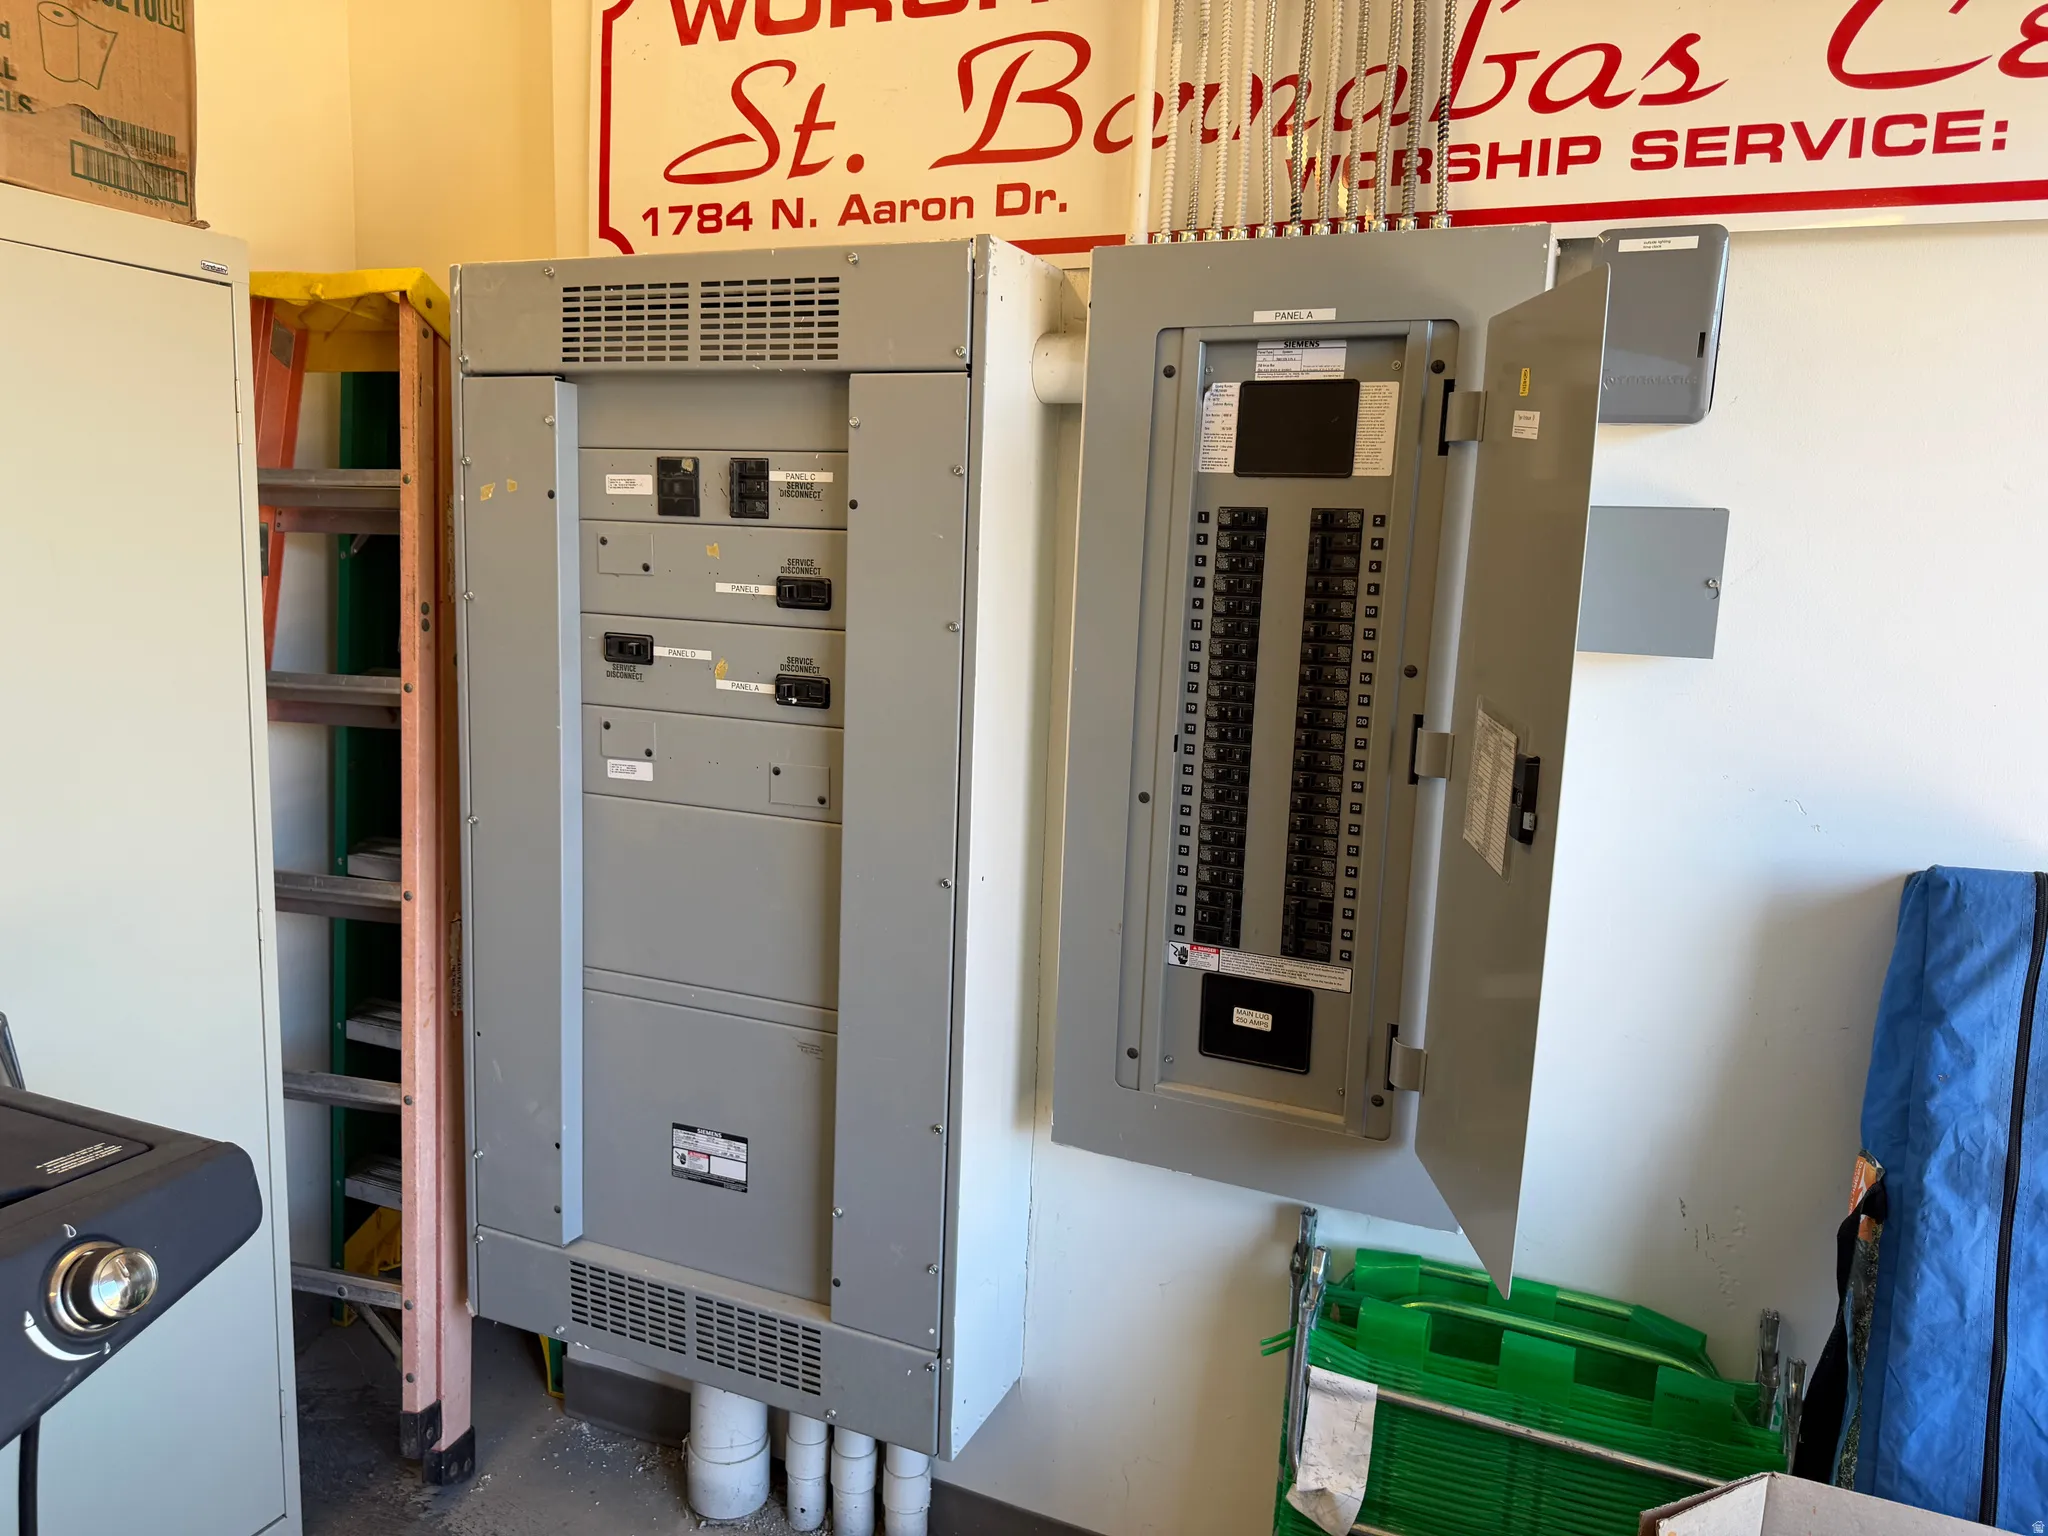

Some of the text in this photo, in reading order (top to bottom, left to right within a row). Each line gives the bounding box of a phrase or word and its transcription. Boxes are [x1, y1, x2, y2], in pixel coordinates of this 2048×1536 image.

[663, 59, 864, 186] St.
[1285, 111, 2009, 194] WORSHIP SERVICE:
[642, 182, 1068, 237] 1784 N. Aaron Dr.
[1275, 311, 1313, 320] PANEL A
[1284, 340, 1320, 348] SIEMENS
[810, 473, 816, 481] C
[786, 481, 814, 490] SERVICE
[779, 489, 821, 499] DISCONNECT
[787, 558, 814, 567] SERVICE
[780, 566, 821, 575] DISCONNECT
[731, 584, 753, 593] PANEL
[668, 649, 689, 657] PANEL
[786, 656, 814, 666] SERVICE
[612, 663, 636, 672] SERVICE
[780, 664, 820, 674] DISCONNECT
[606, 670, 643, 680] DISCONNECT
[731, 682, 752, 691] PANEL
[1236, 1009, 1254, 1017] MAIN
[1236, 1016, 1269, 1028] 250 AMPS
[696, 1128, 722, 1138] SIEMENS
